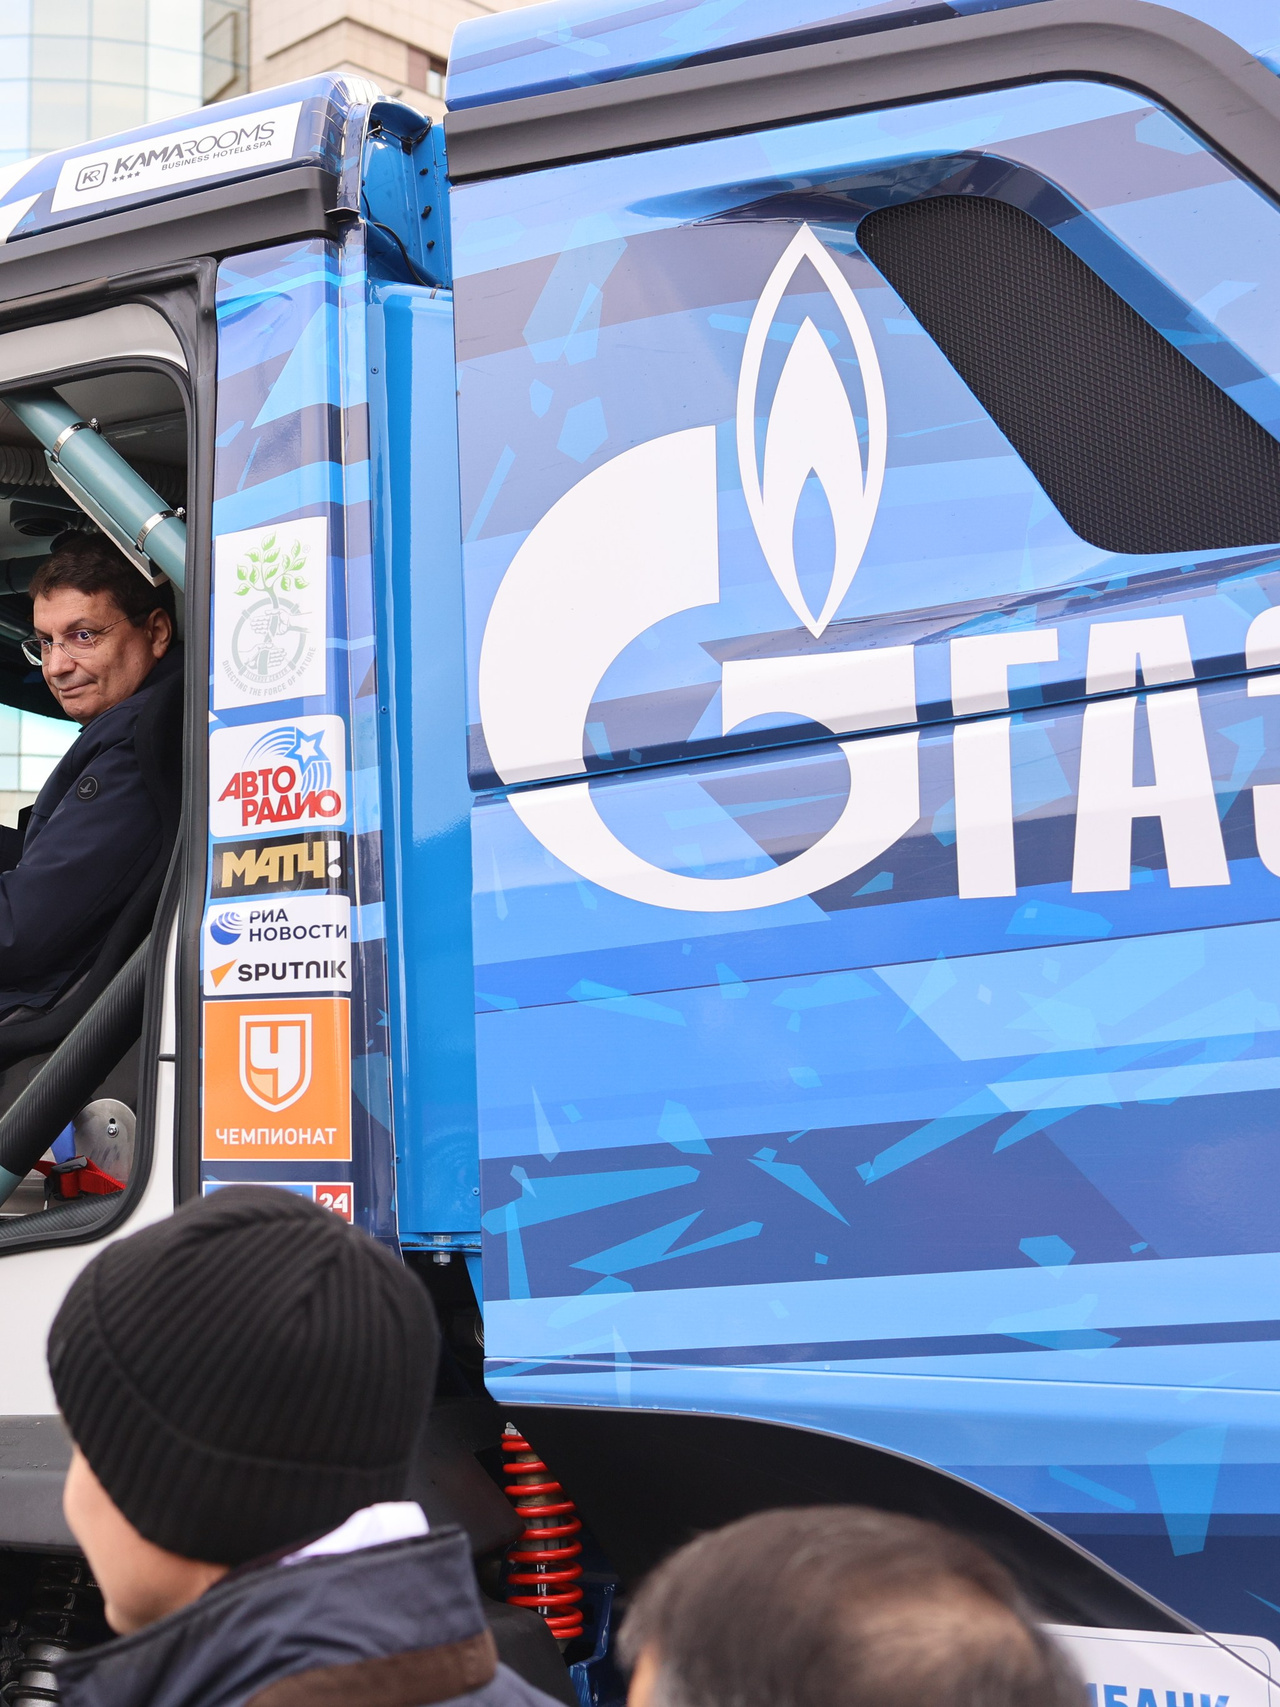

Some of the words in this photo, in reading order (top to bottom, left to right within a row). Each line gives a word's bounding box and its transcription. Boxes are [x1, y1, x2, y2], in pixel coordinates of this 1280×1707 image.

[114, 121, 275, 174] KAMAROOMS
[161, 154, 210, 171] BUSINESS
[222, 660, 248, 692] DIRECTING
[249, 687, 262, 696] THE
[263, 683, 286, 696] FORCE
[287, 675, 297, 686] OF
[296, 646, 316, 677] NATURE
[217, 765, 296, 802] АВТО
[241, 789, 342, 826] РАДИО
[221, 840, 342, 888] МАТЧ!
[249, 909, 289, 924] РИА
[249, 924, 348, 943] НОВОСТИ
[215, 1127, 337, 1145] ЧЕМПИОНАТ
[319, 1192, 349, 1213] 24
